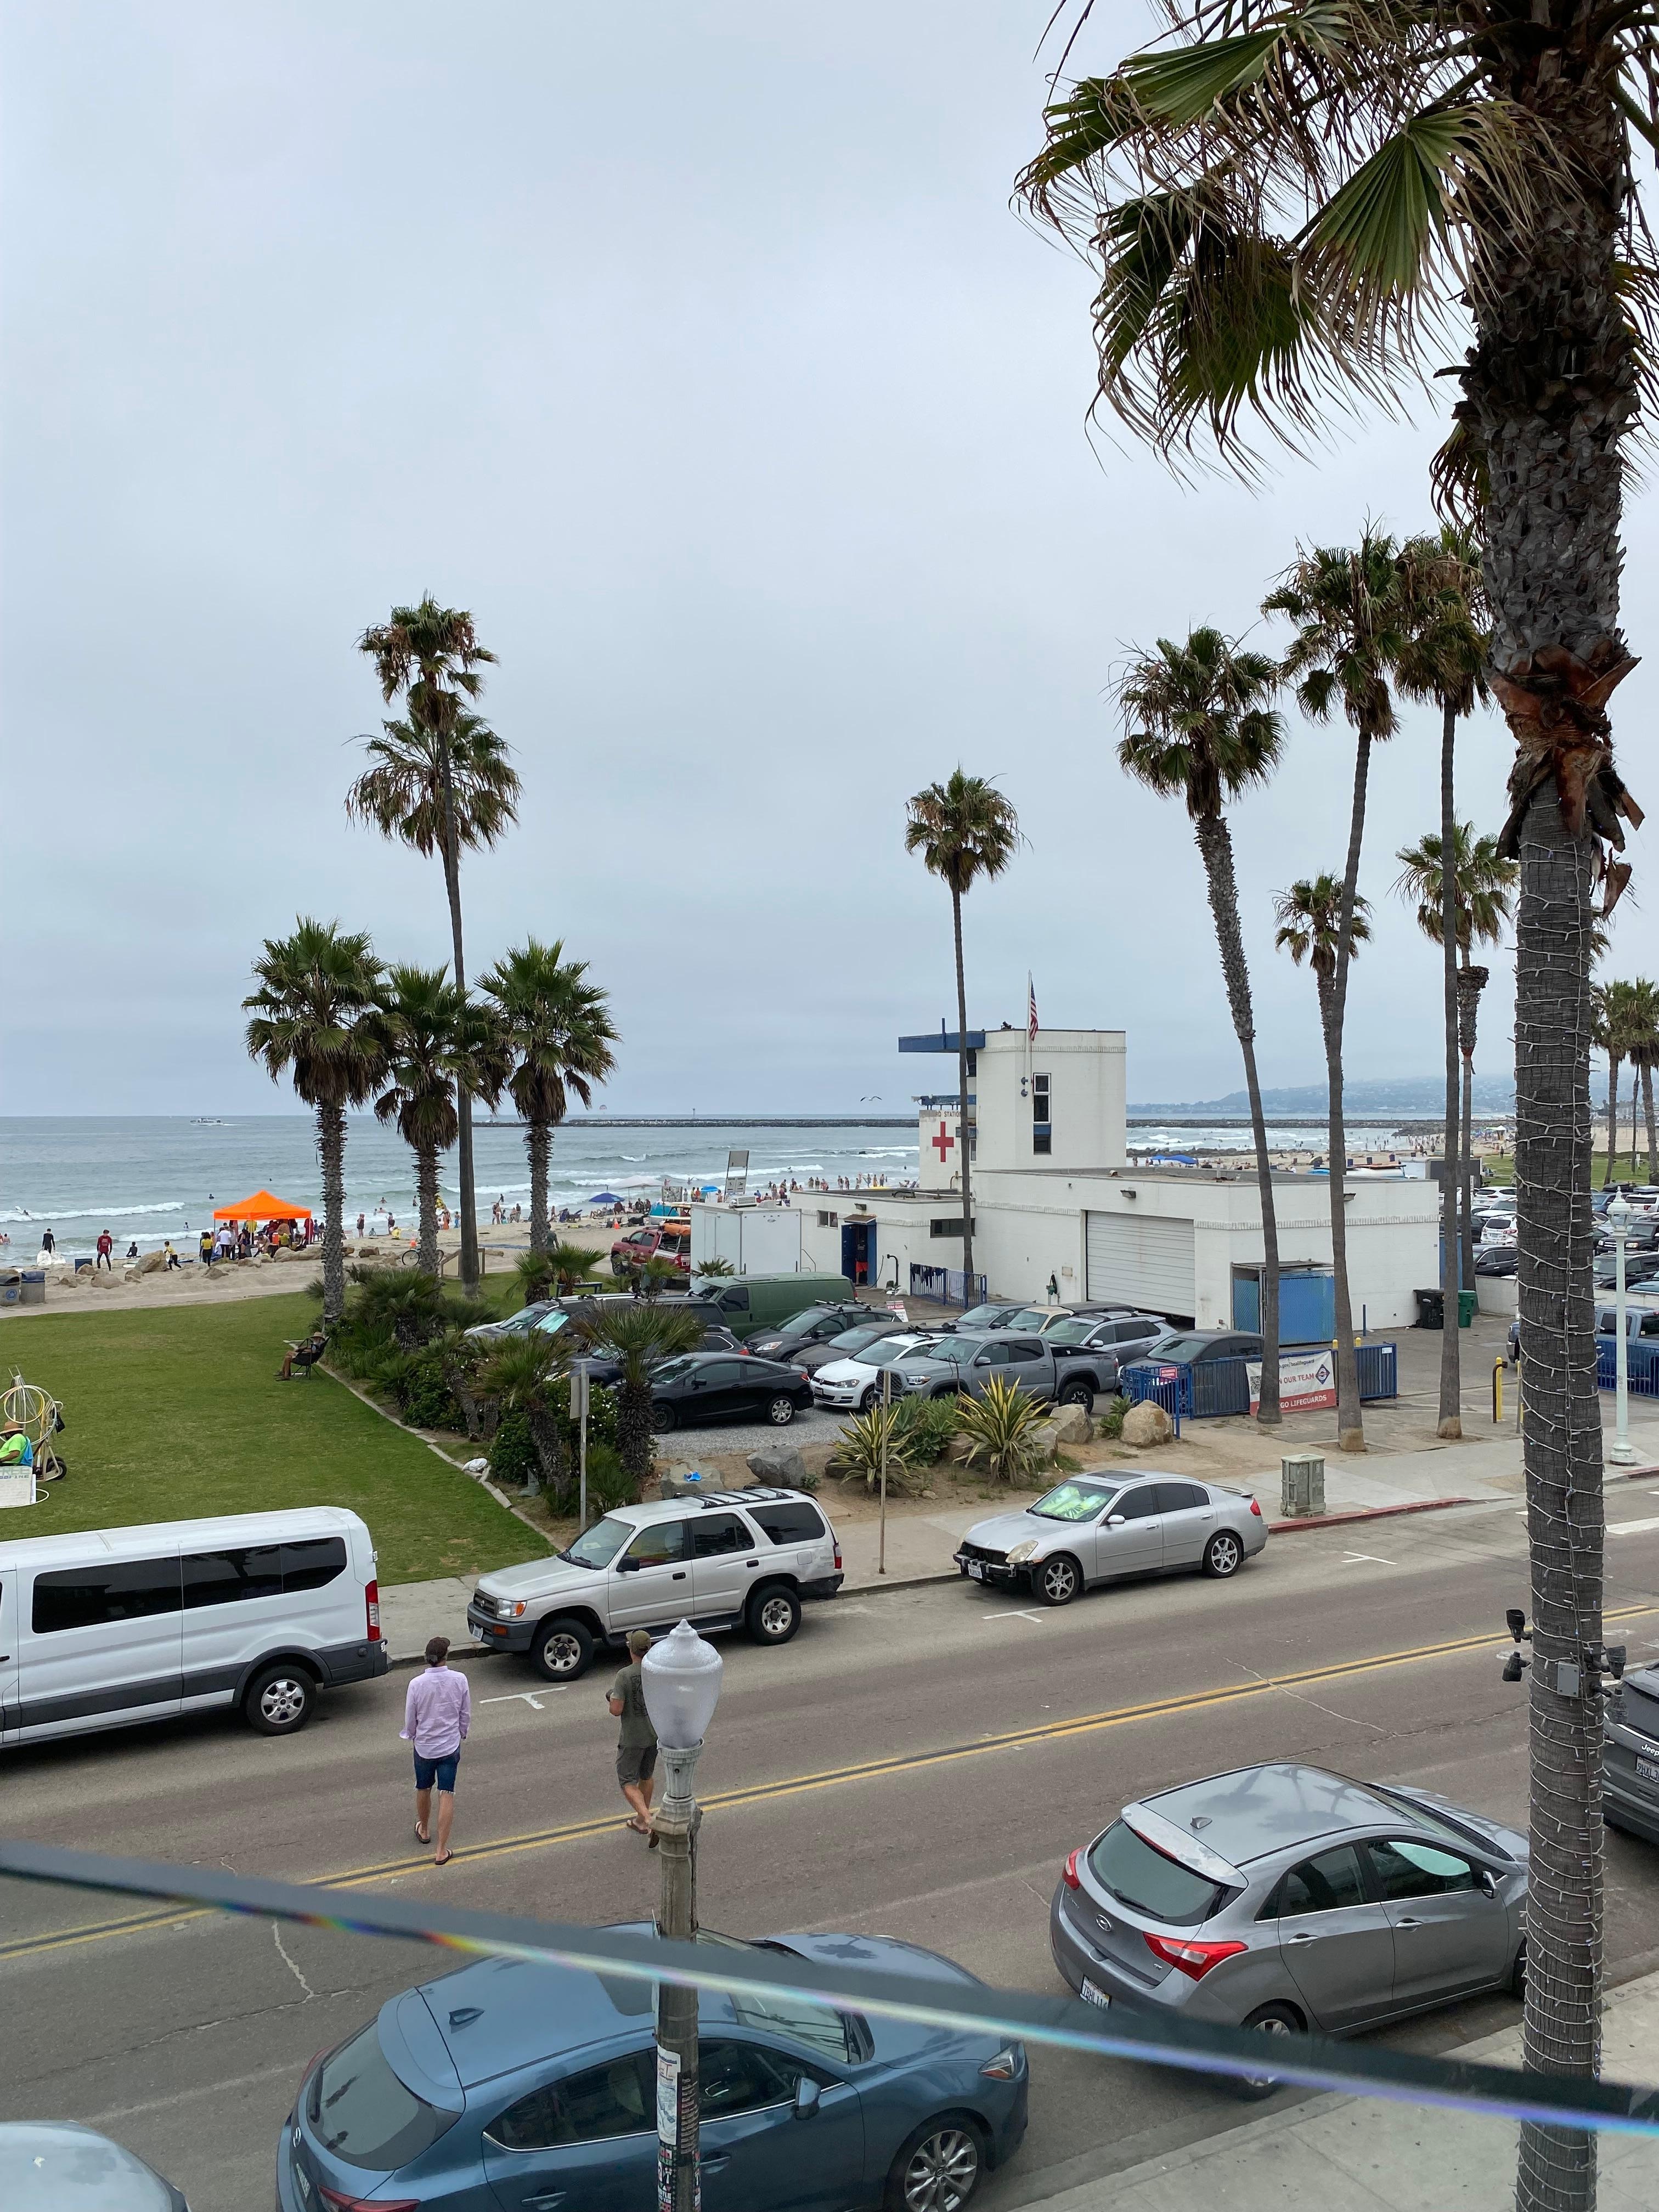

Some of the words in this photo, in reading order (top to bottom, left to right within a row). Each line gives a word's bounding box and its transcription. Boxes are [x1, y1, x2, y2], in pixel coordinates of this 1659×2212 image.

[1297, 1373, 1314, 1381] TEAM
[1290, 1395, 1327, 1407] LIFEGUARDS
[1641, 1743, 1659, 1757] Jeep
